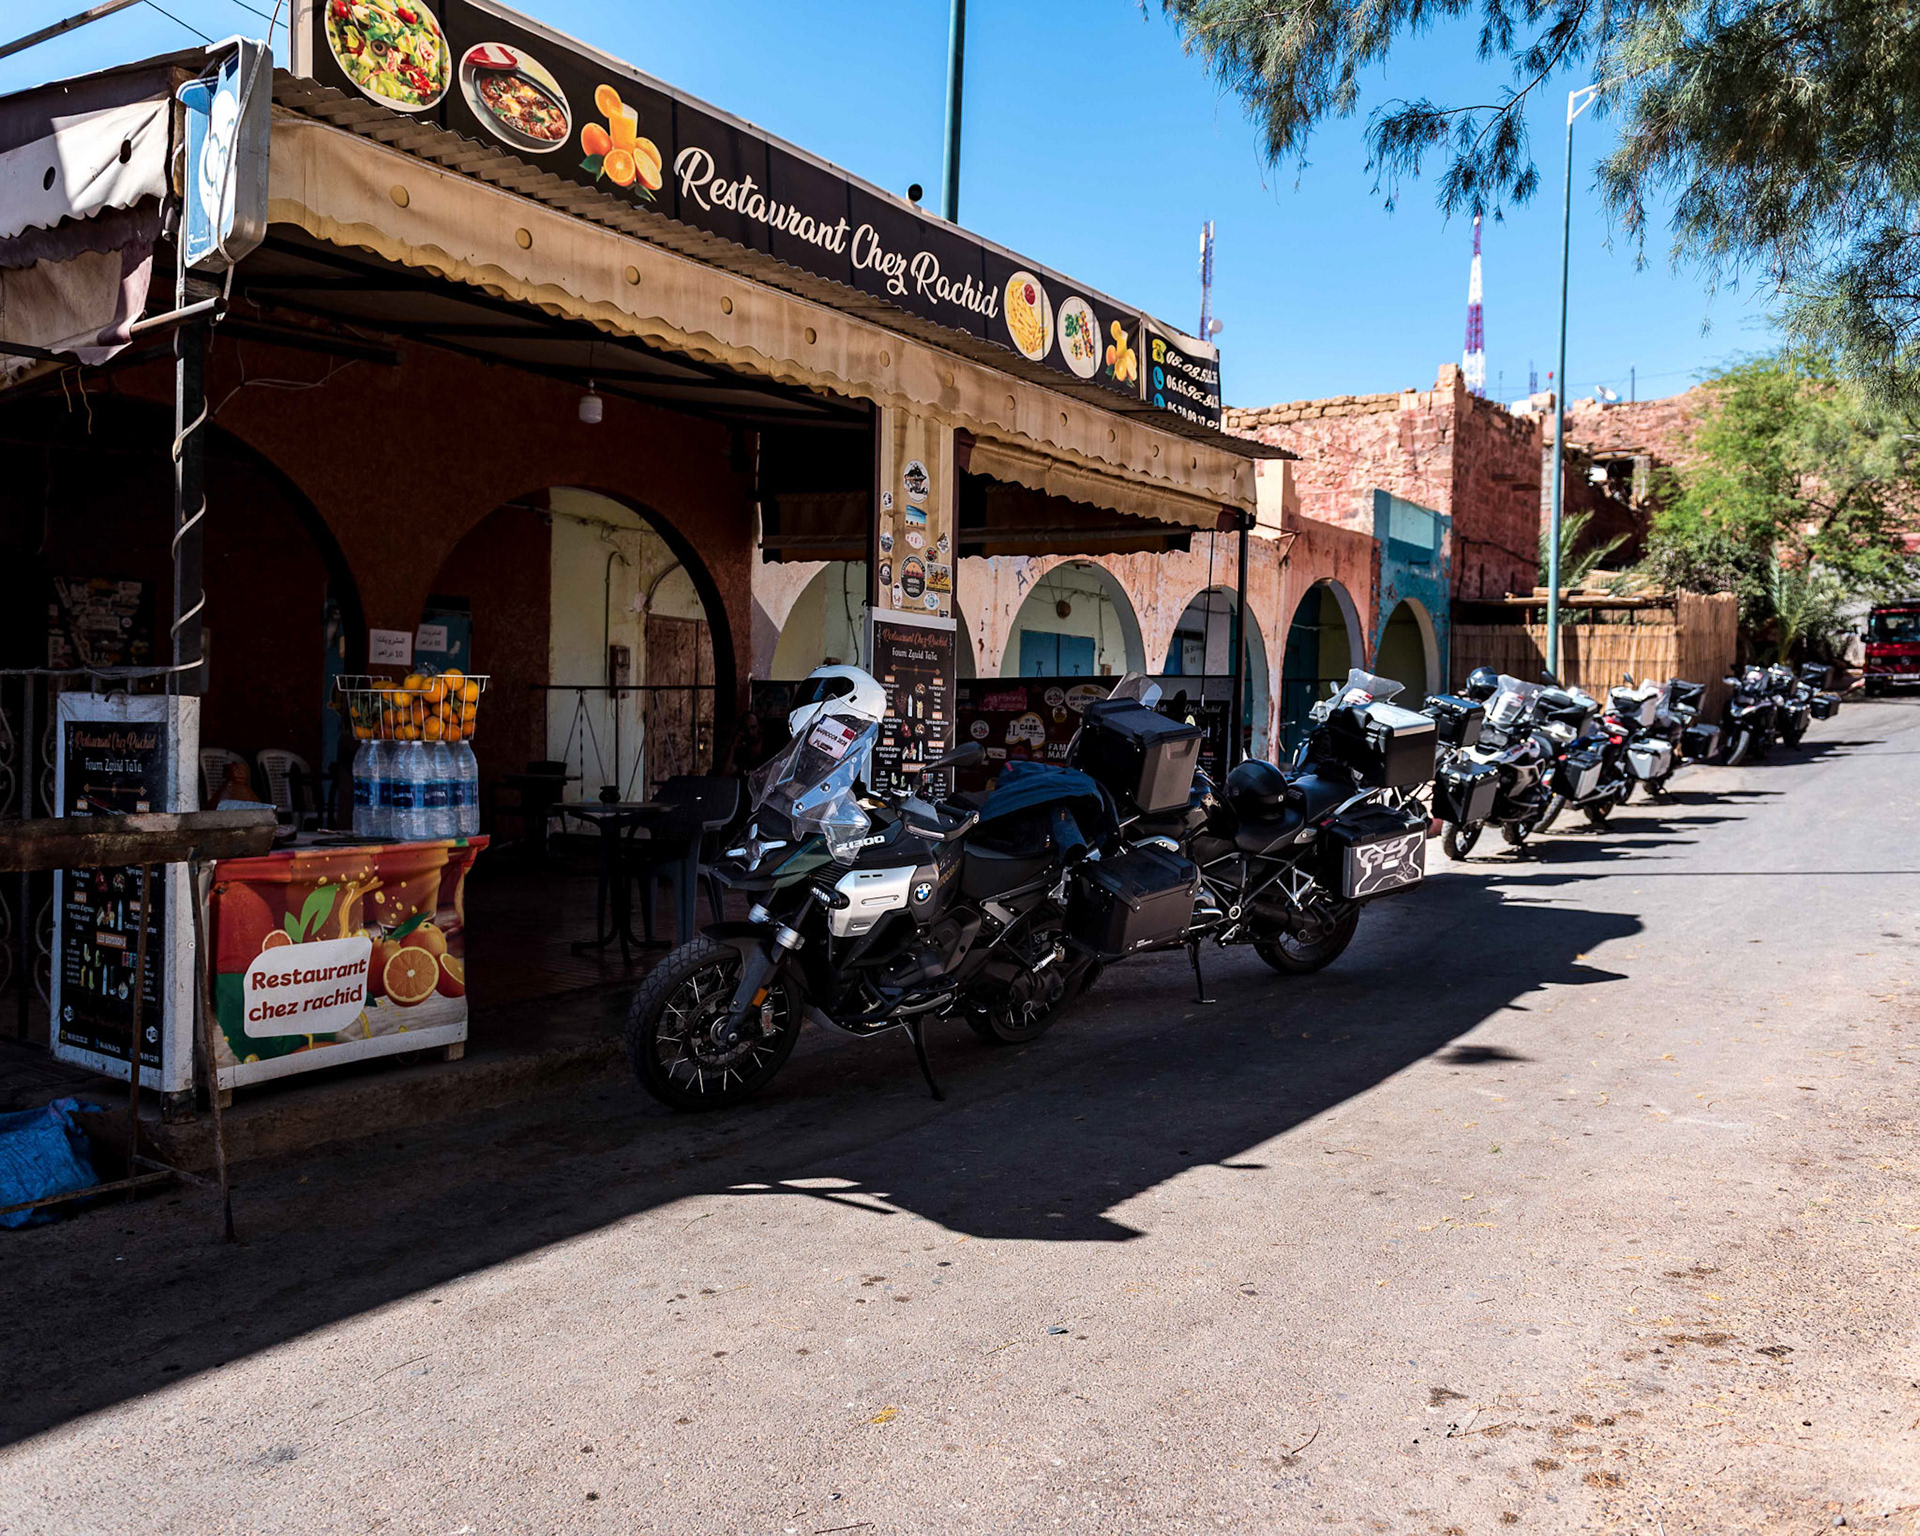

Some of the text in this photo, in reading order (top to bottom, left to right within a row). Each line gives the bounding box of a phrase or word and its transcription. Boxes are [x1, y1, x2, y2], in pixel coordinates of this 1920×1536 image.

[673, 146, 999, 319] Restaurant Chez Rachid
[892, 647, 938, 661] Foum Zguid TaTa
[85, 757, 142, 775] Foum Zguid TaTa
[252, 958, 367, 991] Restaurant
[249, 984, 362, 1021] chez rachid
